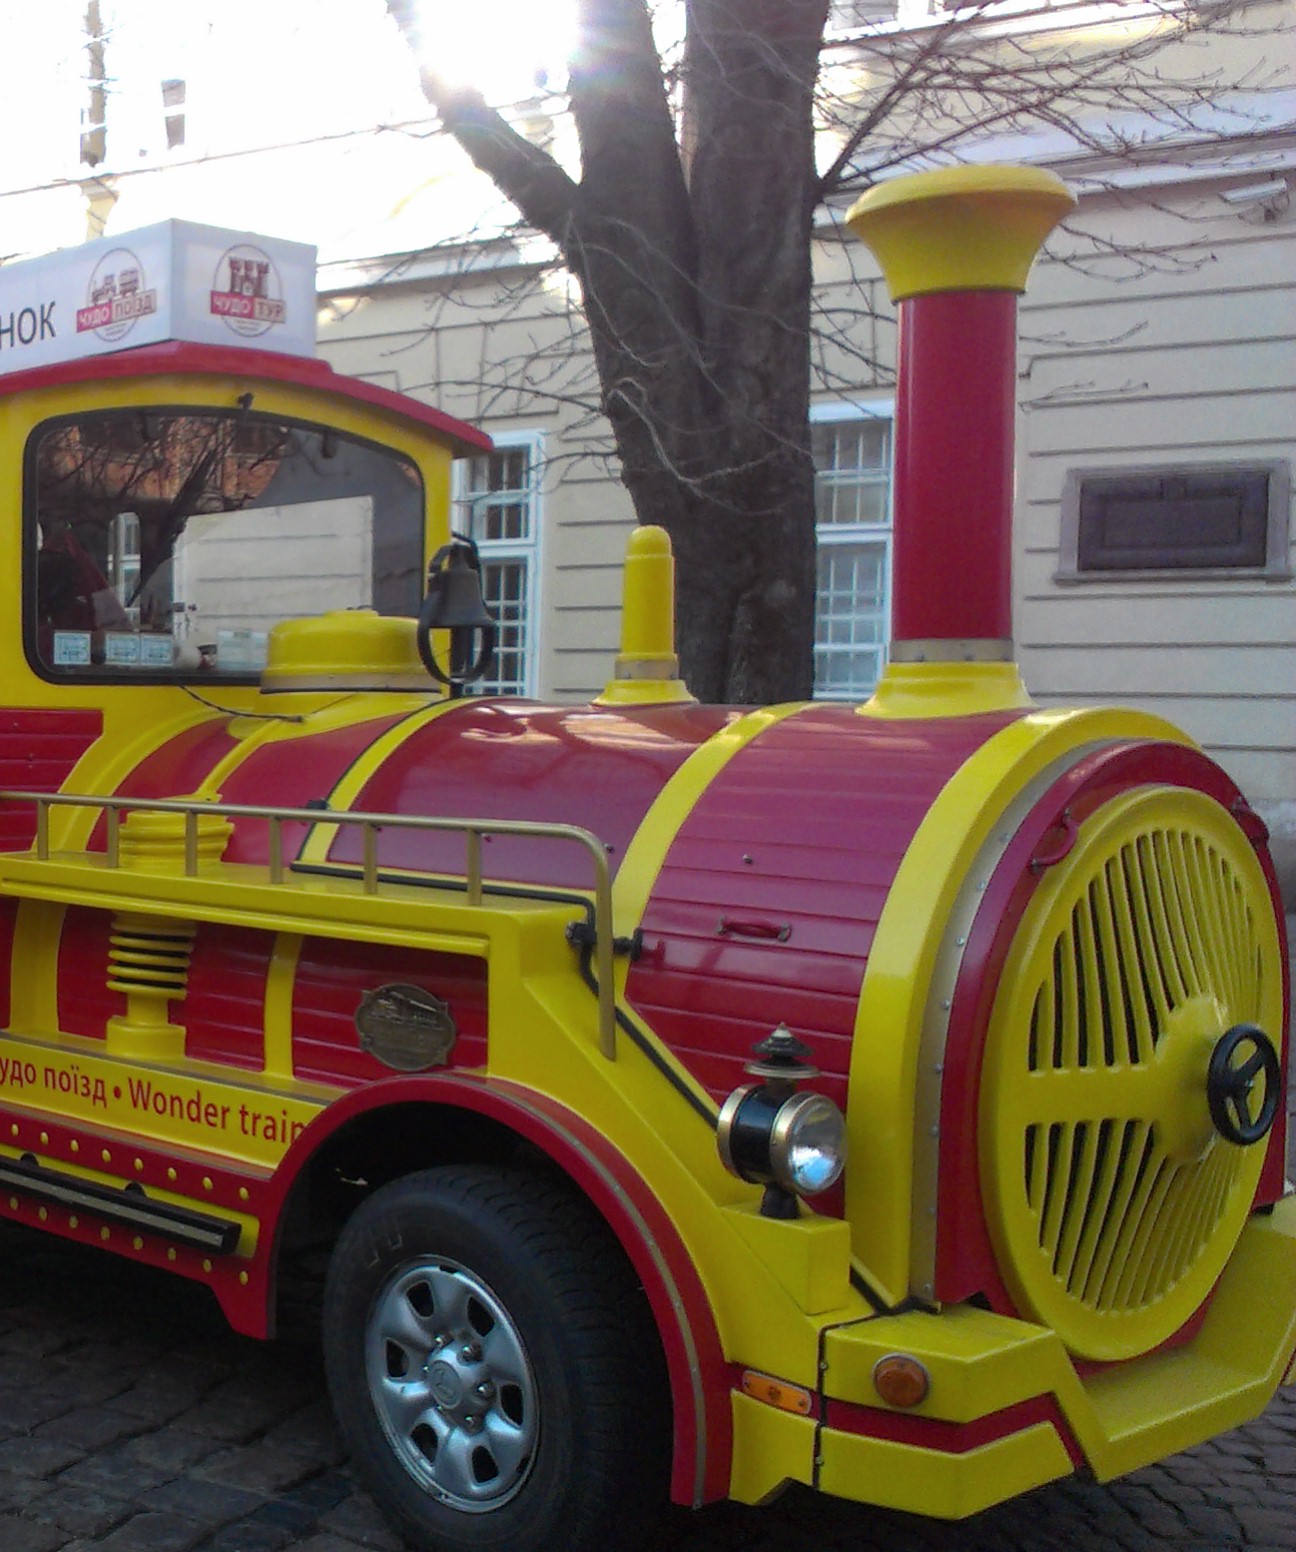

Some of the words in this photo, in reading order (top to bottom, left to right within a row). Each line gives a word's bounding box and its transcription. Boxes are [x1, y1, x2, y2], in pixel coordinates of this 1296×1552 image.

[79, 306, 109, 326] ЧУДО
[214, 296, 251, 314] ЧУДО
[257, 301, 282, 318] ТУР
[44, 1064, 107, 1108] поїзд
[128, 1077, 230, 1131] Wonder
